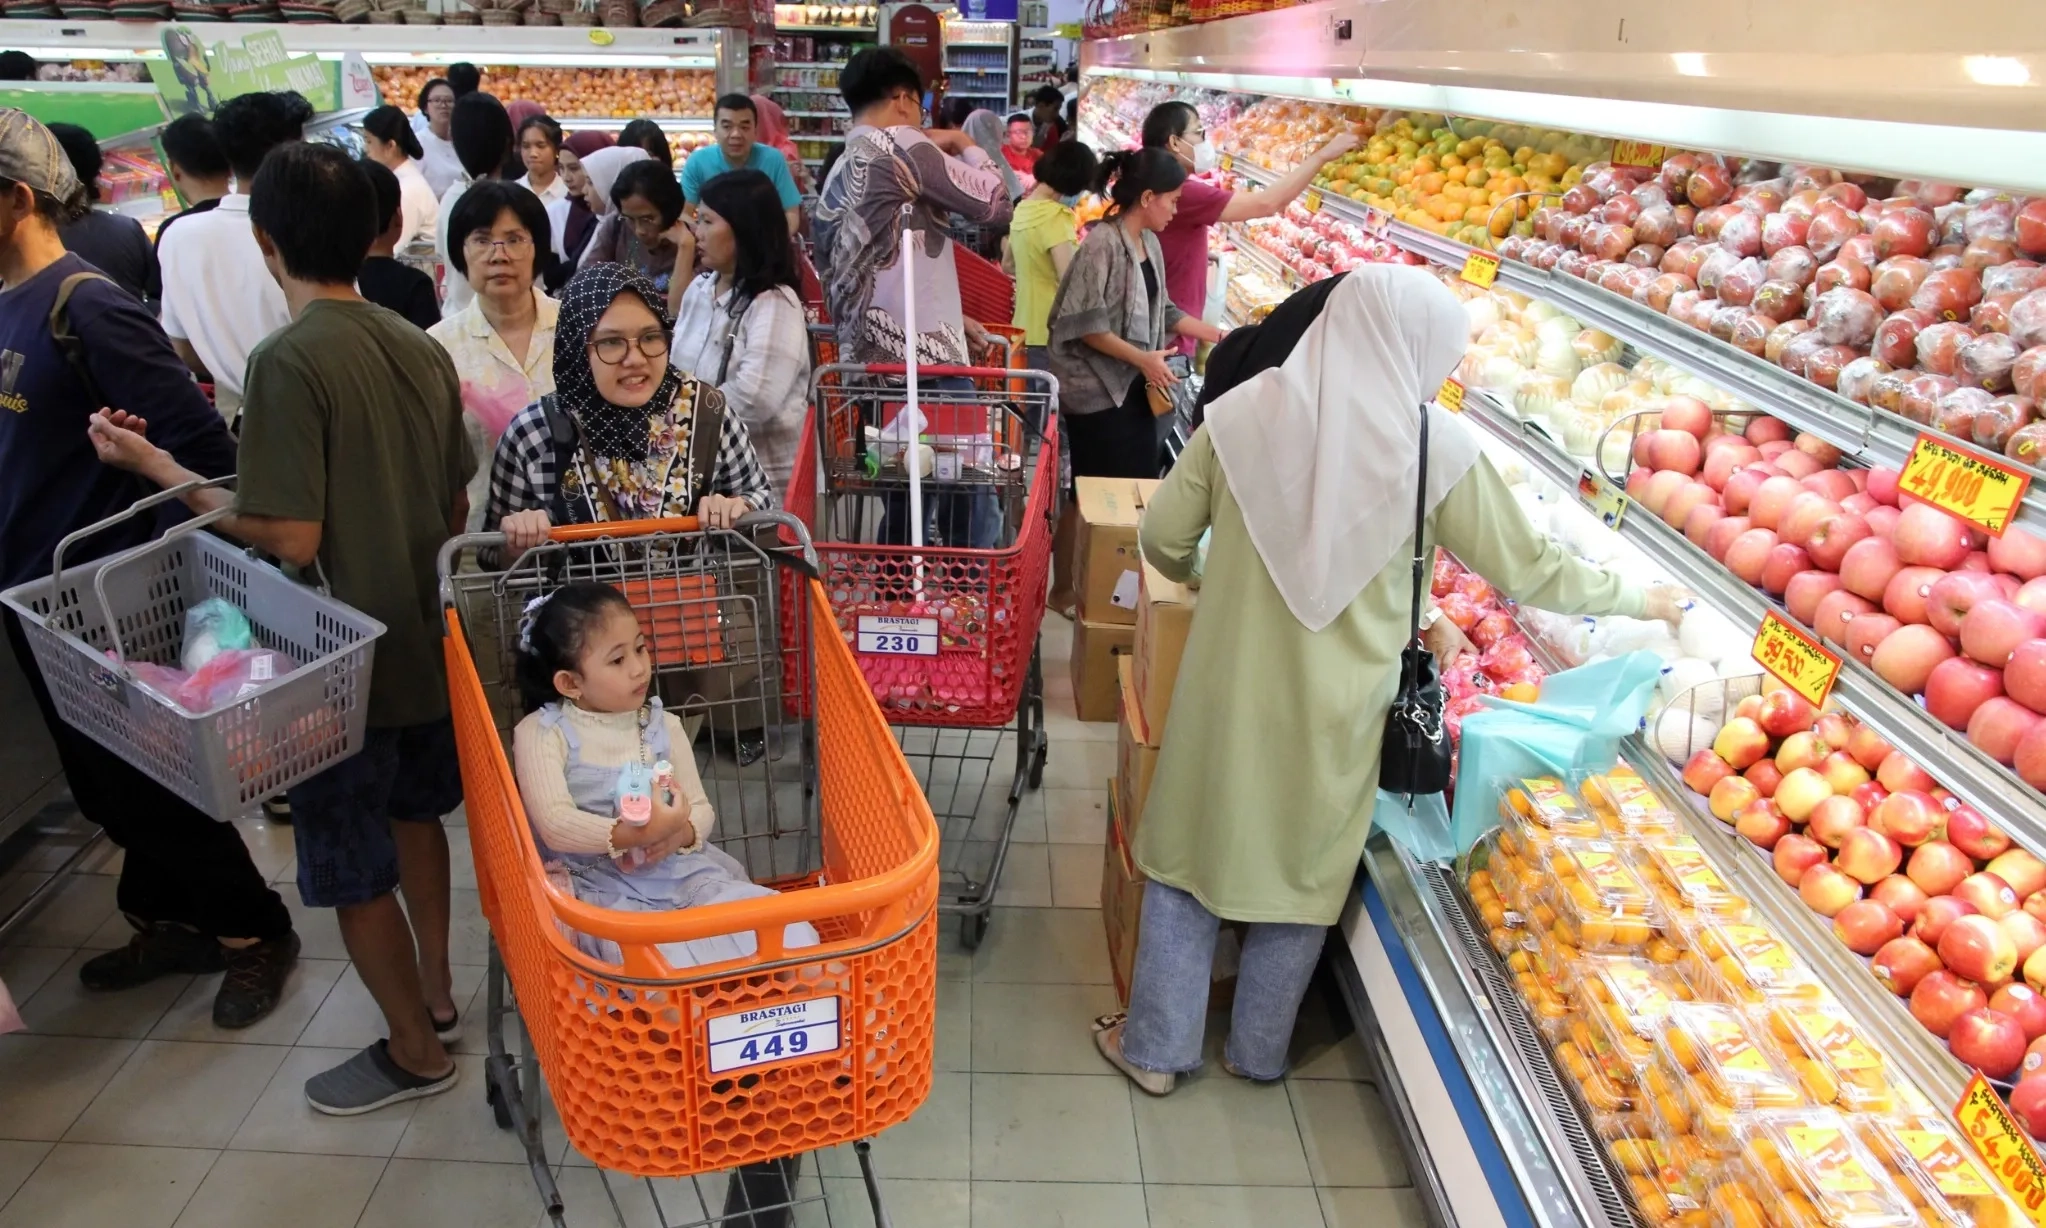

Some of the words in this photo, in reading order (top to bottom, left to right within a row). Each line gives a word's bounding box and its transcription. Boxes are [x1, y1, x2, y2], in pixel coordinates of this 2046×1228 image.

[877, 617, 920, 625] BRASTAGI
[876, 635, 919, 652] 230
[740, 1003, 807, 1023] BRASTAGI
[740, 1030, 808, 1061] 449
